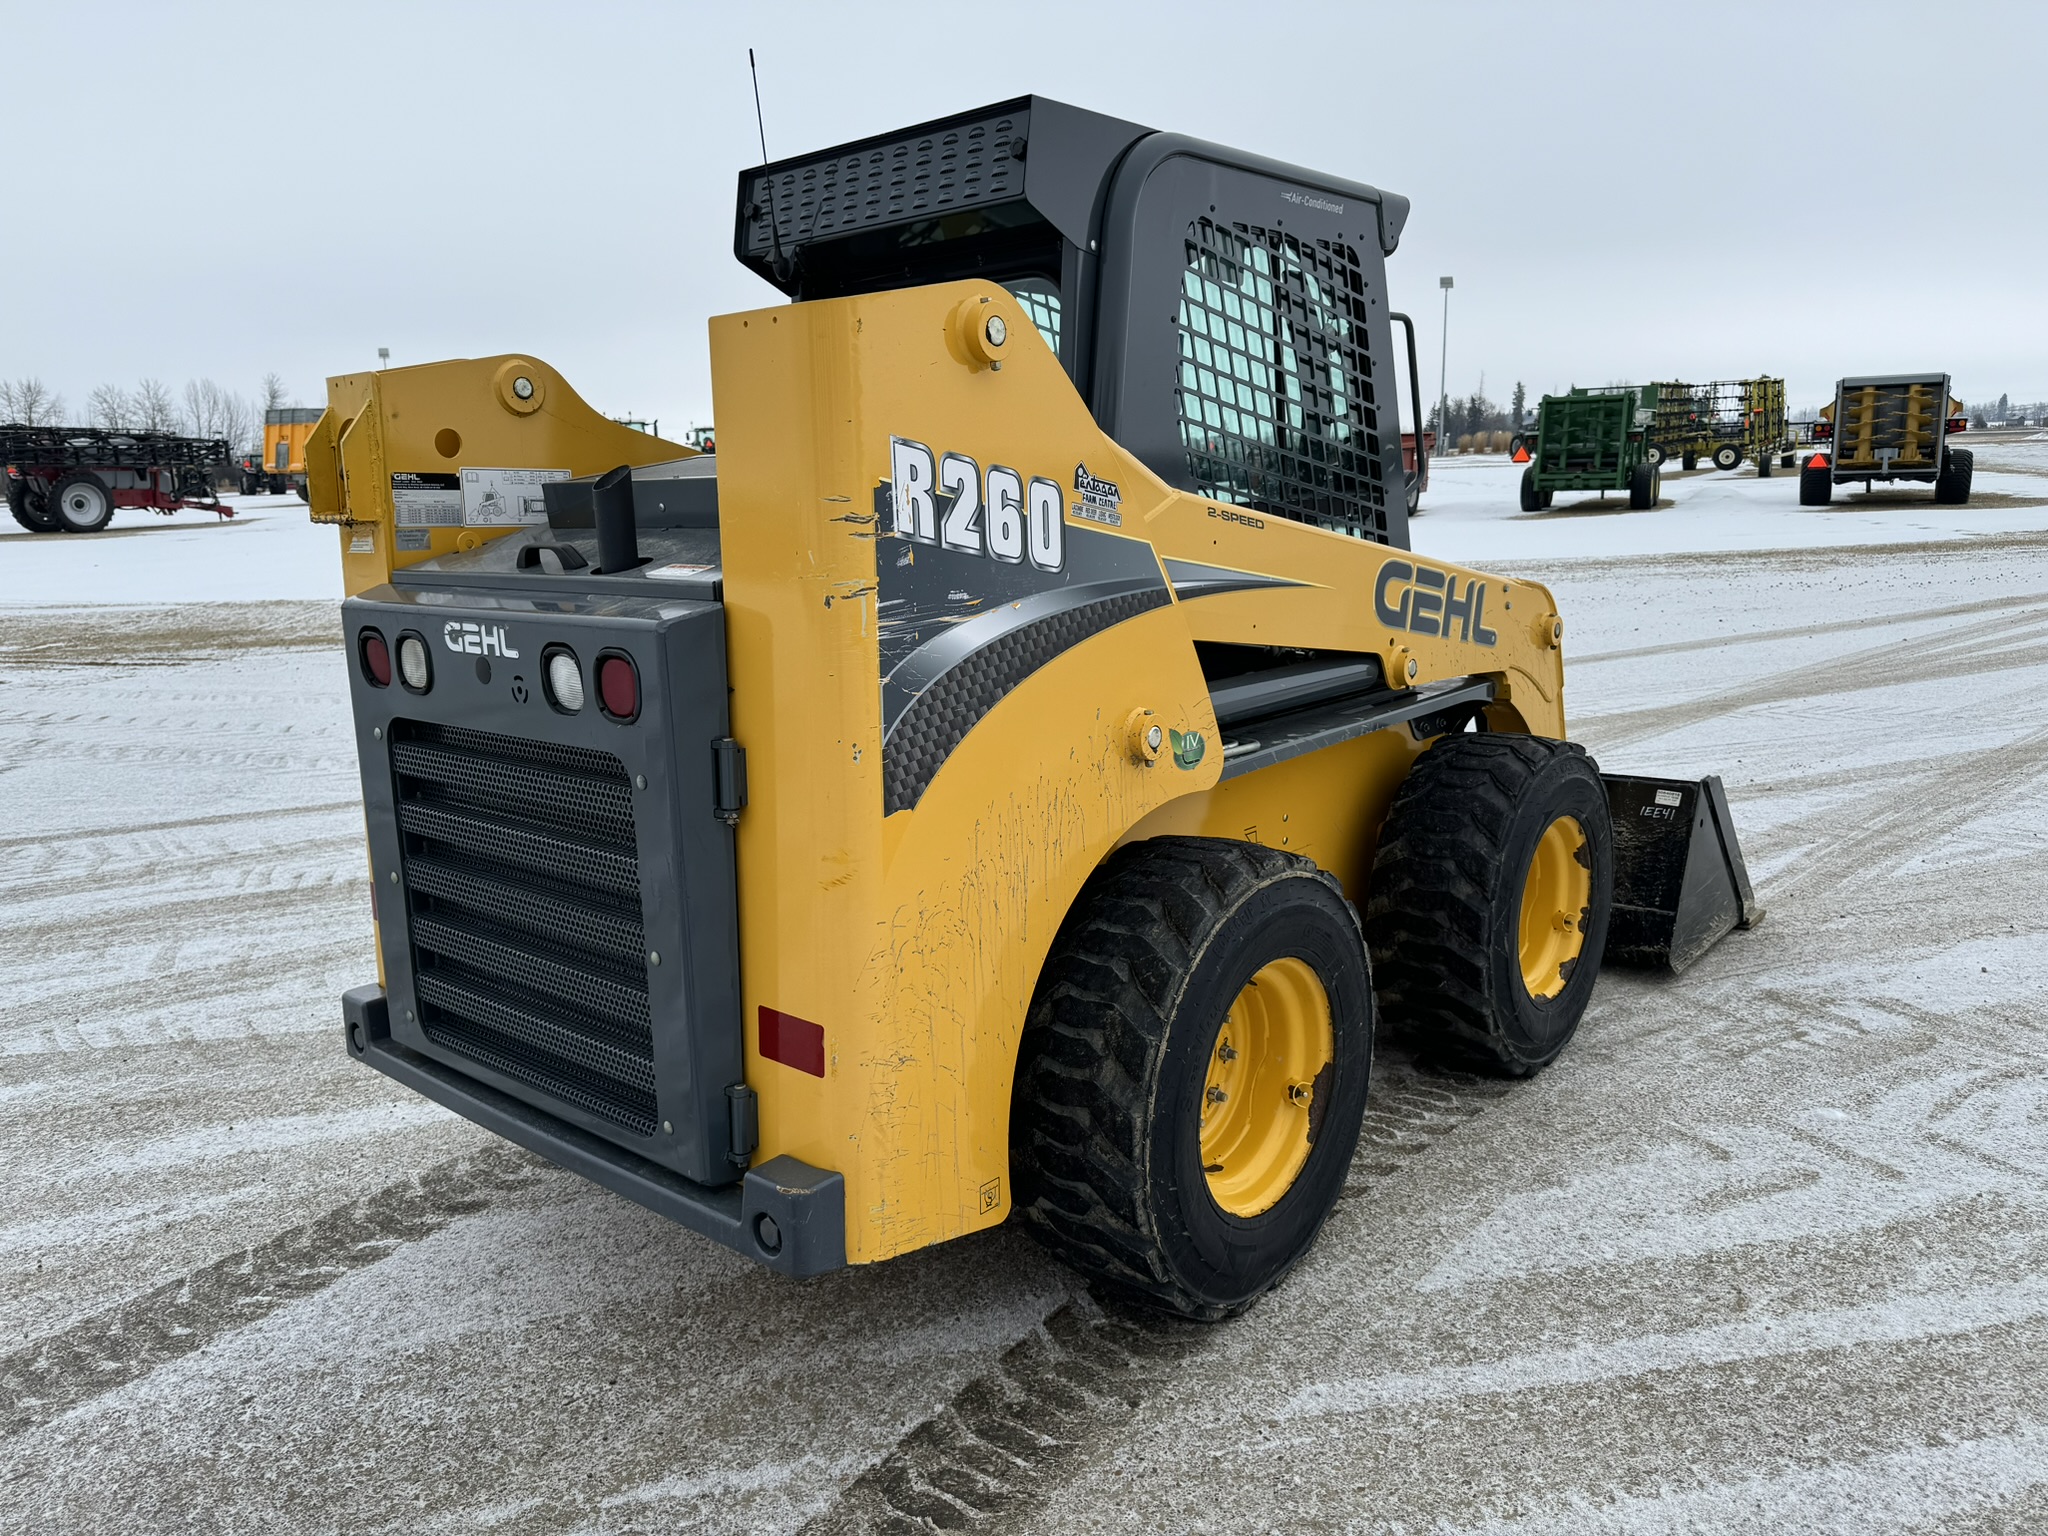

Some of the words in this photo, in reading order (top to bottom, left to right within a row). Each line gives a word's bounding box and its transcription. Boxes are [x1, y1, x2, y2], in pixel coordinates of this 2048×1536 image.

[1291, 192, 1344, 215] Air-Conditioned
[393, 473, 421, 481] GEHL
[889, 434, 1066, 574] R260
[1098, 497, 1117, 510] CENTRE
[1207, 506, 1265, 530] 2-SPEED
[1373, 558, 1497, 647] GEHL
[444, 621, 520, 659] GEHL
[1186, 732, 1200, 750] IV
